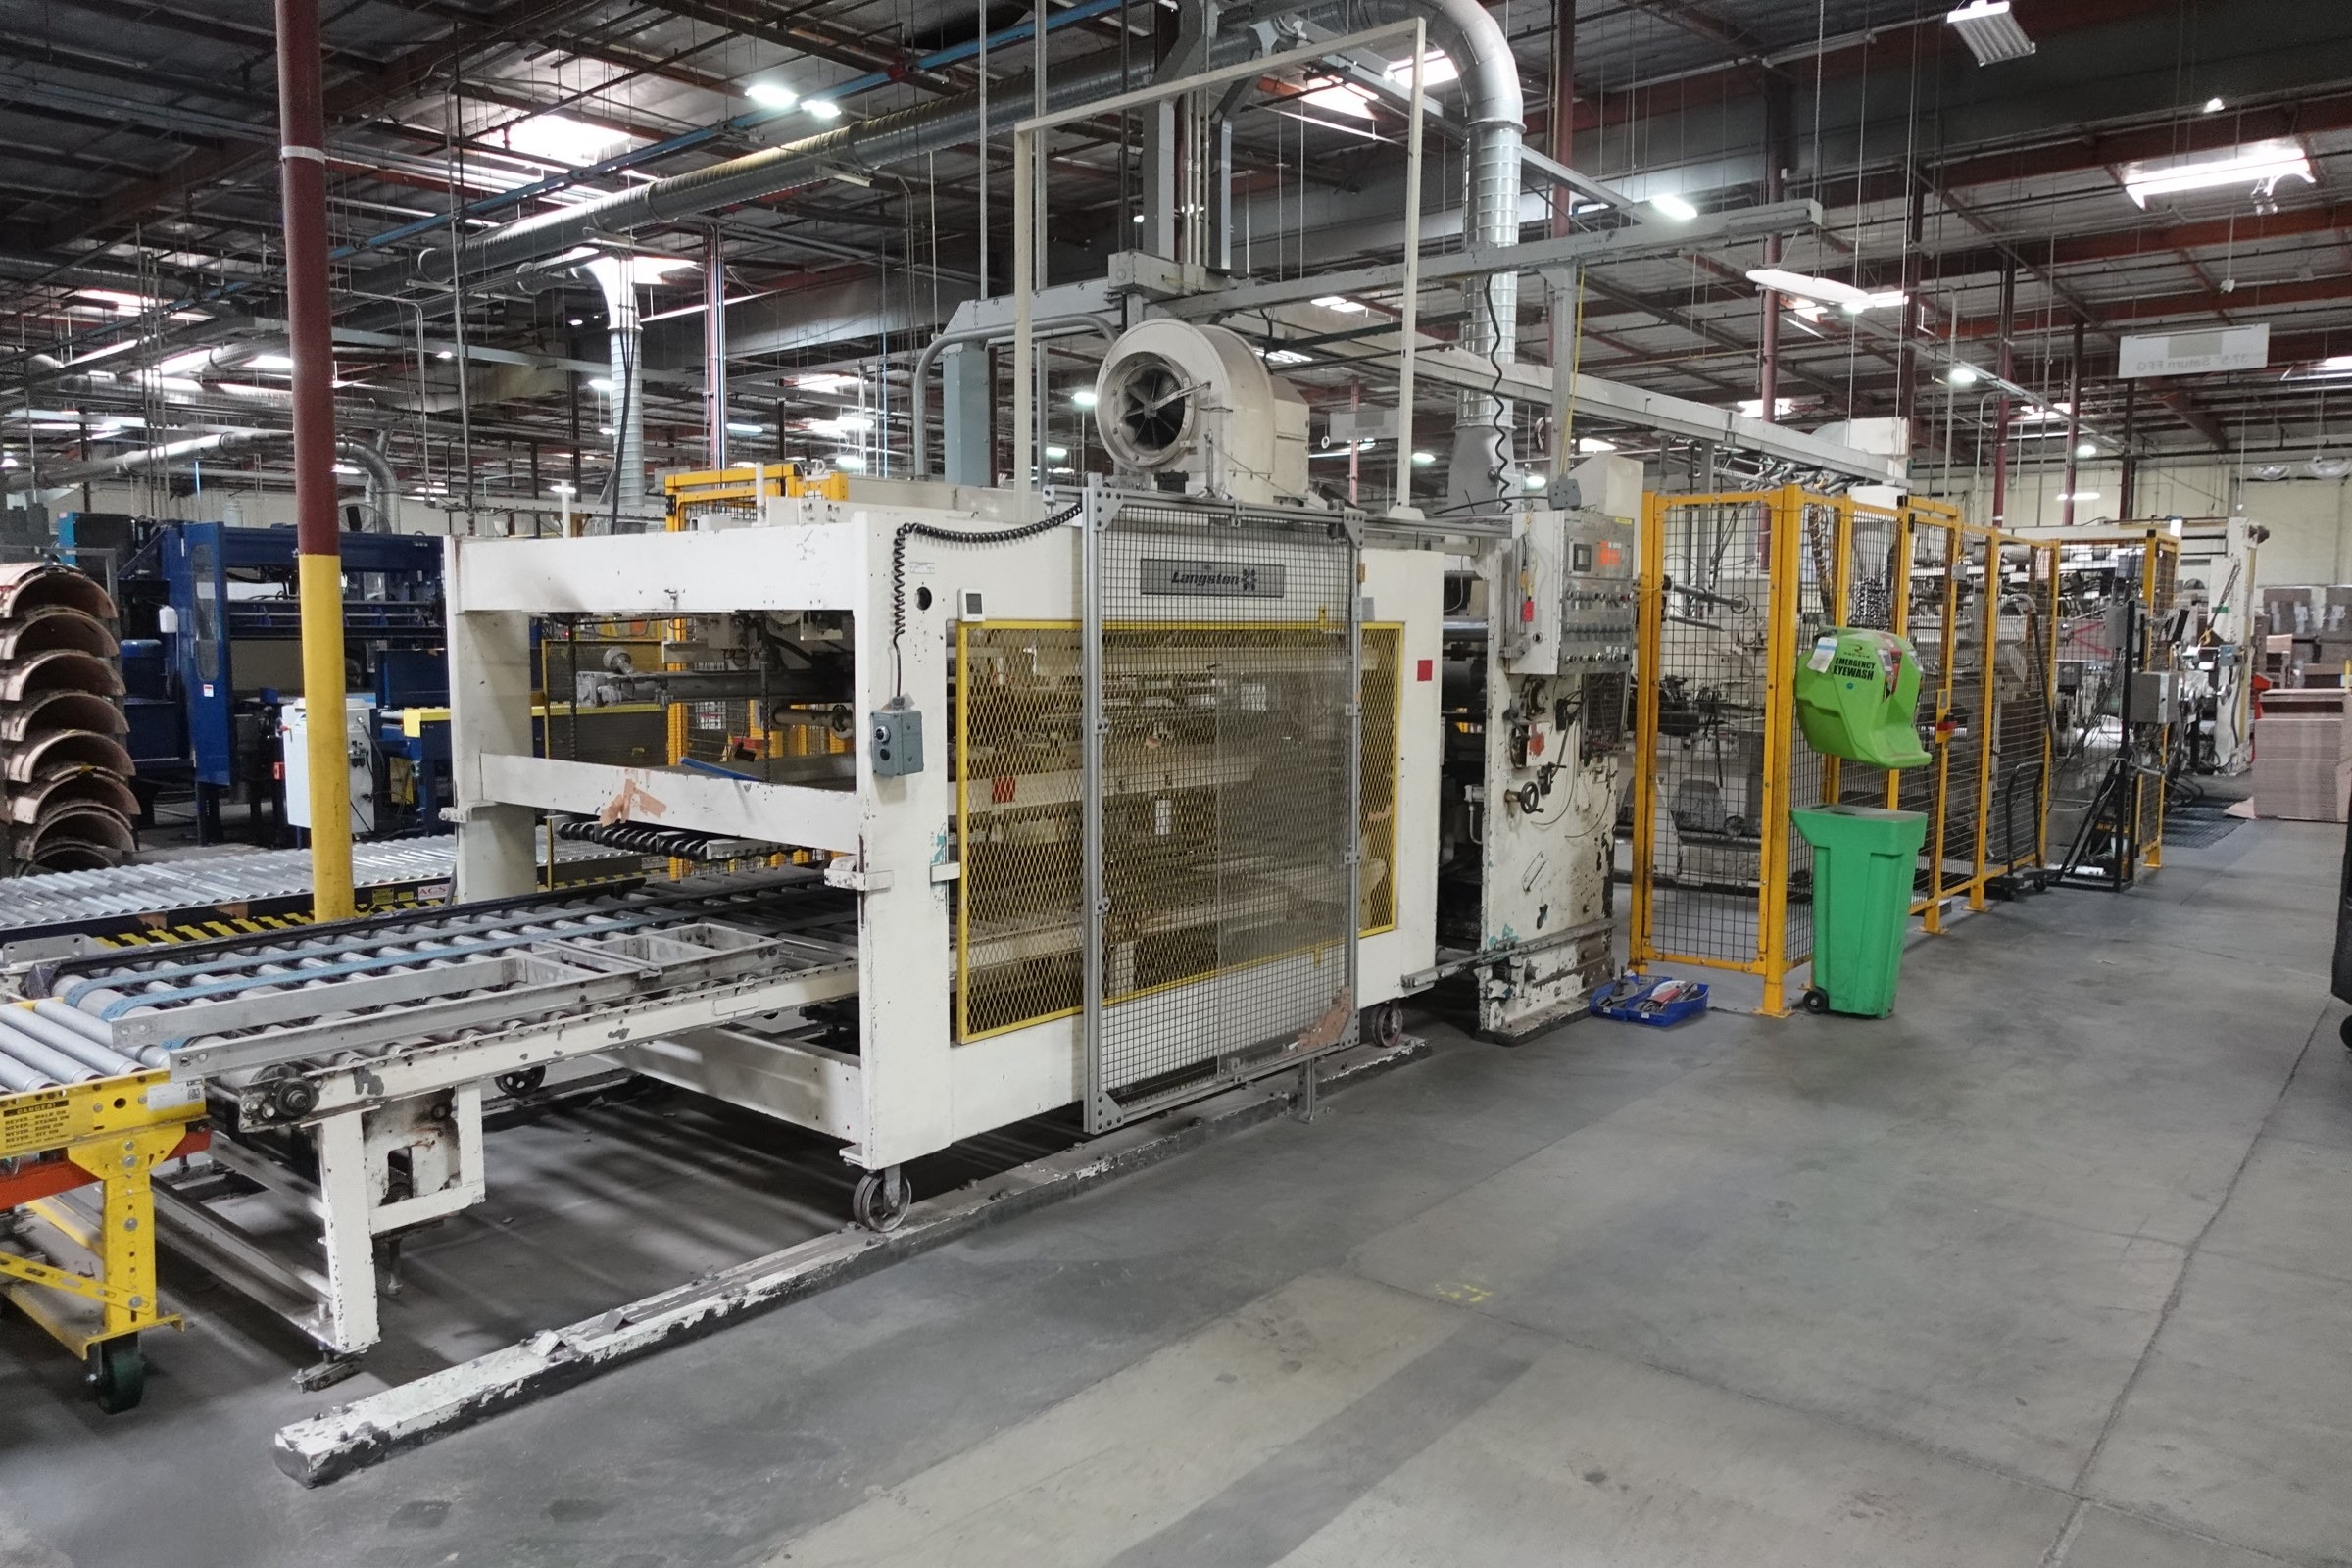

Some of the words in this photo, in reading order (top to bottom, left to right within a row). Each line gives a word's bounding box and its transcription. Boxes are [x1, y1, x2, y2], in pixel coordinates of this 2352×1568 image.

[1171, 571, 1240, 586] Langston
[1835, 657, 1876, 670] EMERGENCY
[1833, 664, 1875, 681] EYEWASH
